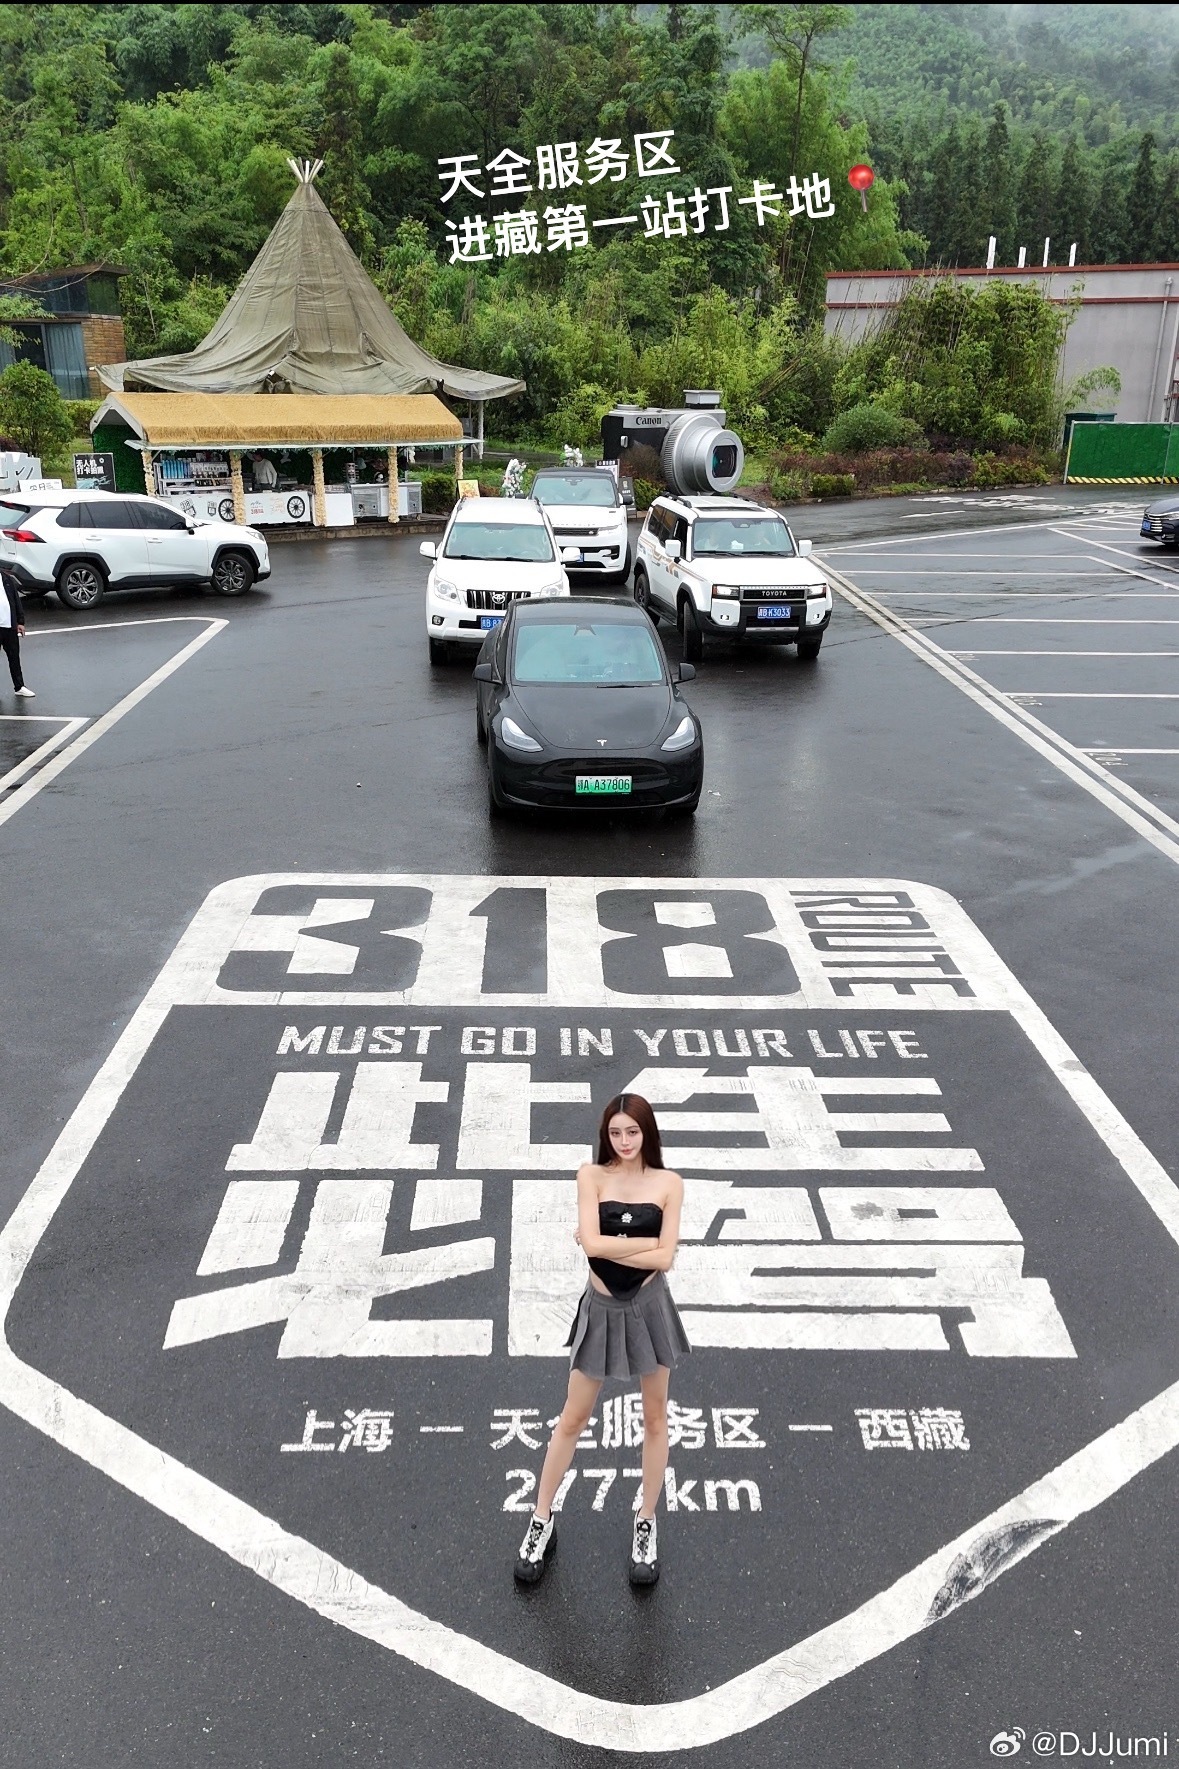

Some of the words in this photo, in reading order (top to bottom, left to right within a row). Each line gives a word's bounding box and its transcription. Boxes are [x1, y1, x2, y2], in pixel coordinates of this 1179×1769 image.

[635, 415, 662, 426] Canon
[594, 779, 630, 791] A37806
[215, 884, 802, 996] 318
[788, 890, 977, 998] ROUTE
[275, 1025, 442, 1055] MUST
[460, 1026, 537, 1056] GO
[559, 1027, 614, 1056] IN
[633, 1028, 794, 1058] YOUR
[806, 1029, 929, 1059] LIFE
[225, 1060, 986, 1172] 此生
[163, 1178, 1079, 1359] 必驾
[280, 1408, 395, 1453] 上海
[853, 1406, 971, 1451] 西藏
